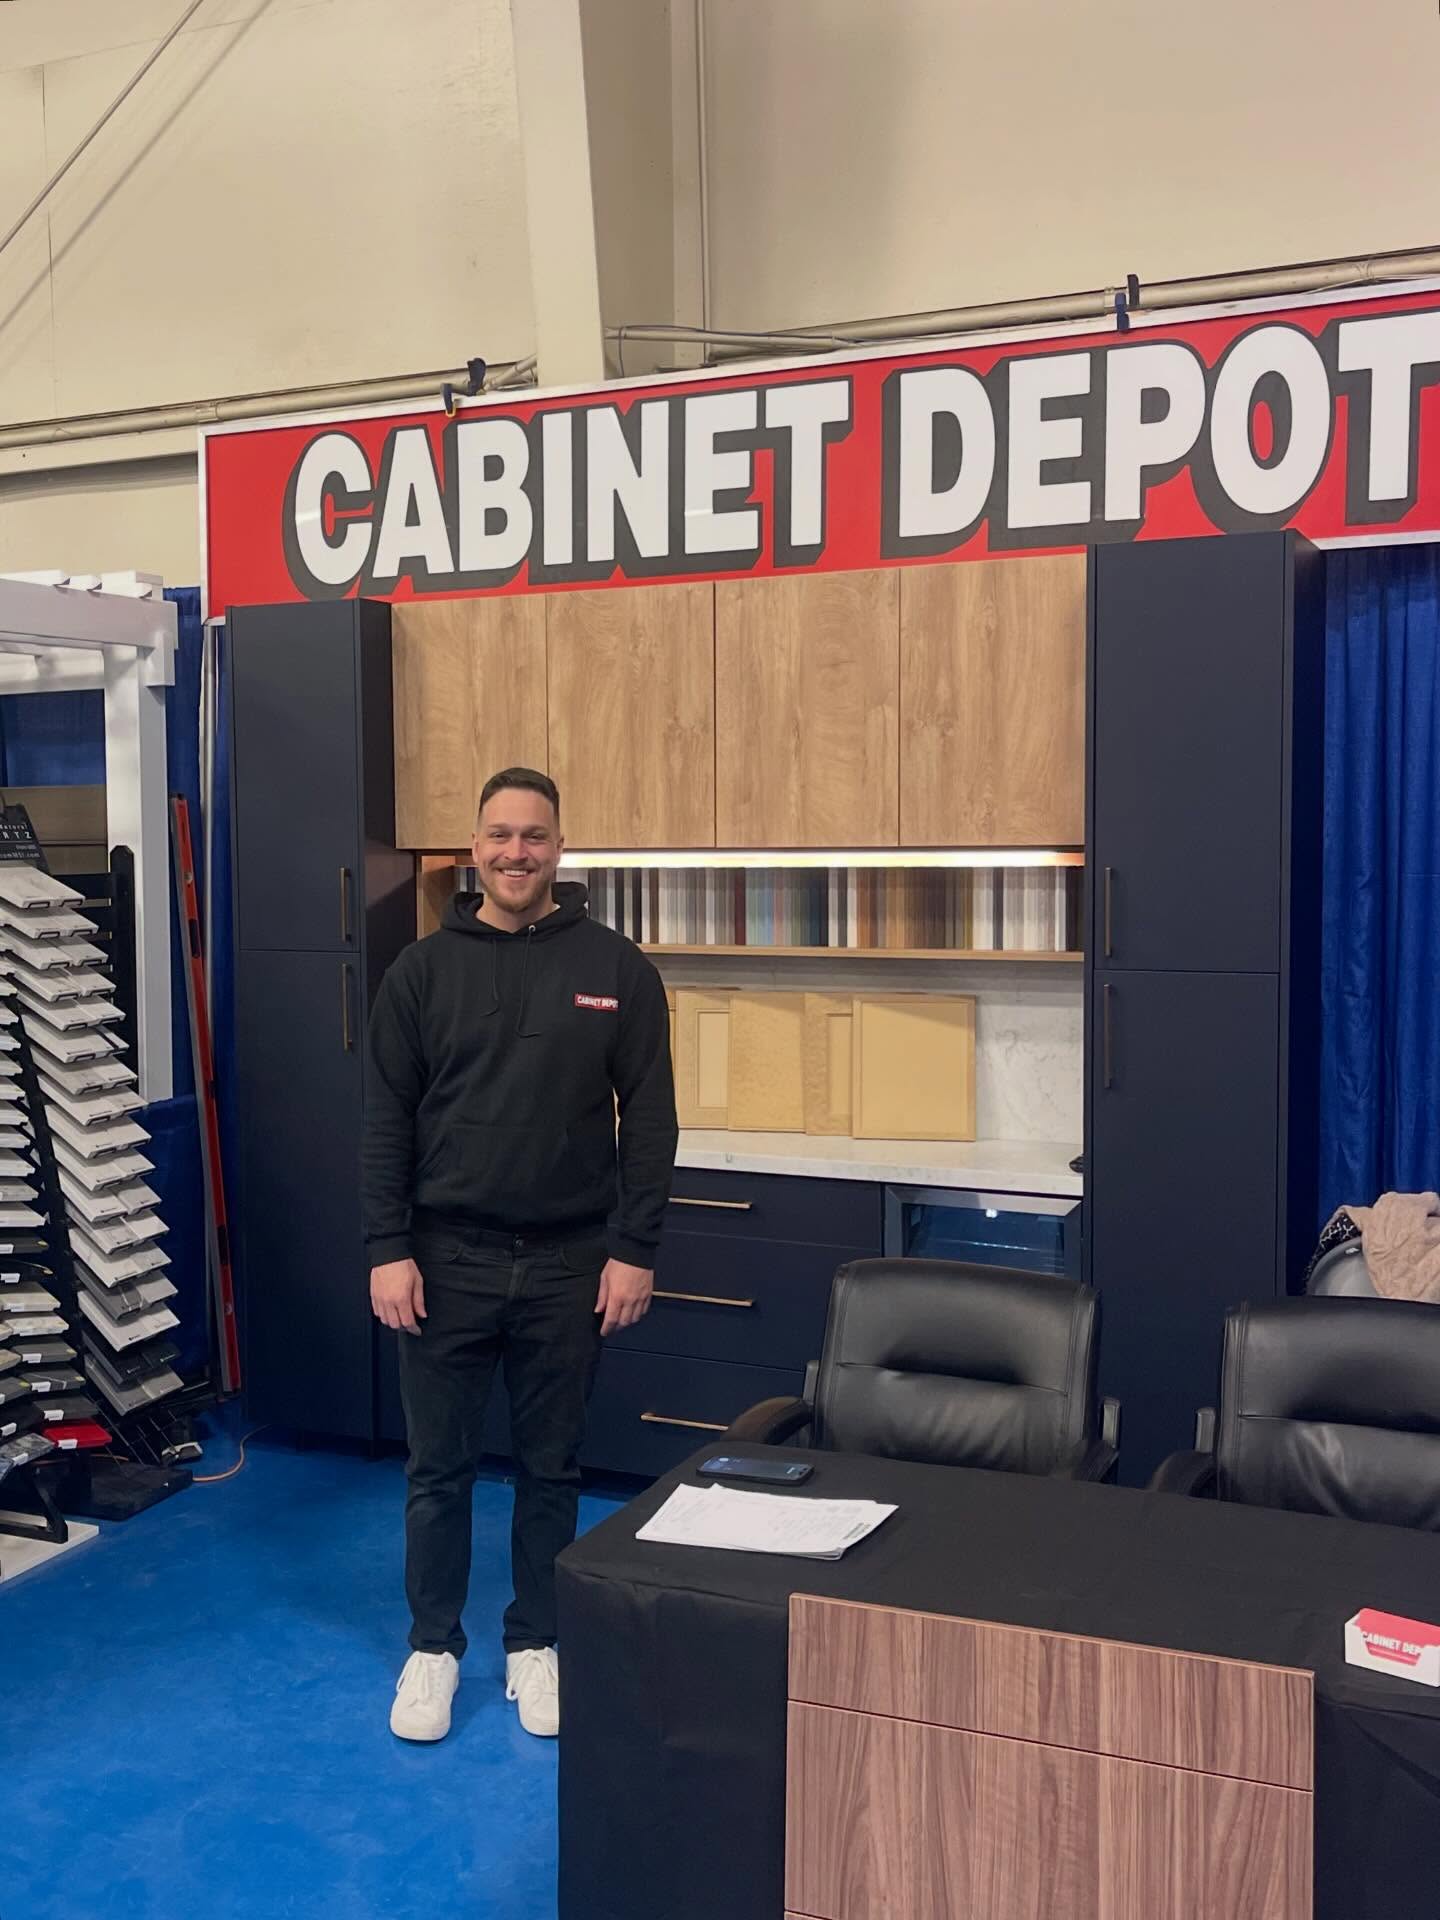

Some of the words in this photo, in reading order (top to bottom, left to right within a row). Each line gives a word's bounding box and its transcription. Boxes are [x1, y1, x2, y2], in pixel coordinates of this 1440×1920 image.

[292, 379, 850, 587] CABINET
[897, 310, 1440, 539] DEPOT
[0, 831, 32, 840] RTZ
[577, 995, 601, 1007] CABINET
[601, 997, 619, 1009] DEPO
[1361, 1631, 1402, 1651] CABINET
